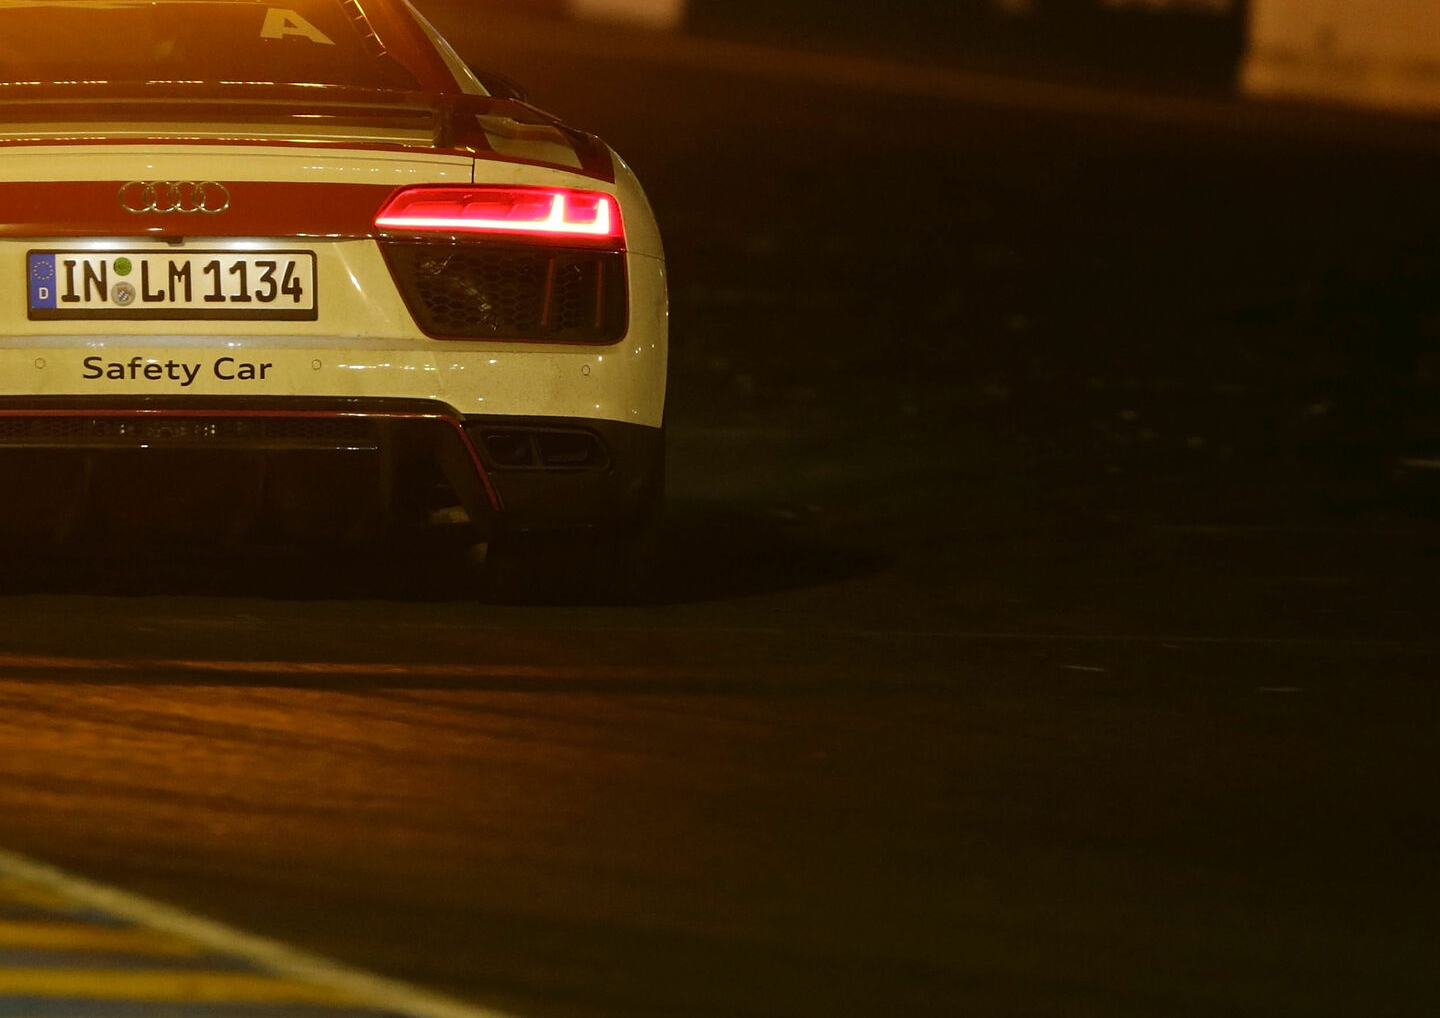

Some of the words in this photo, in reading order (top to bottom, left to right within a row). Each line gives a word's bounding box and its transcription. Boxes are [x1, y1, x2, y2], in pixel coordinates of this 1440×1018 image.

[260, 7, 335, 45] A
[39, 287, 49, 300] D
[61, 260, 107, 302] IN
[141, 260, 192, 302] LM
[203, 260, 303, 303] 1134
[82, 356, 201, 386] Safety
[213, 357, 273, 380] Car
